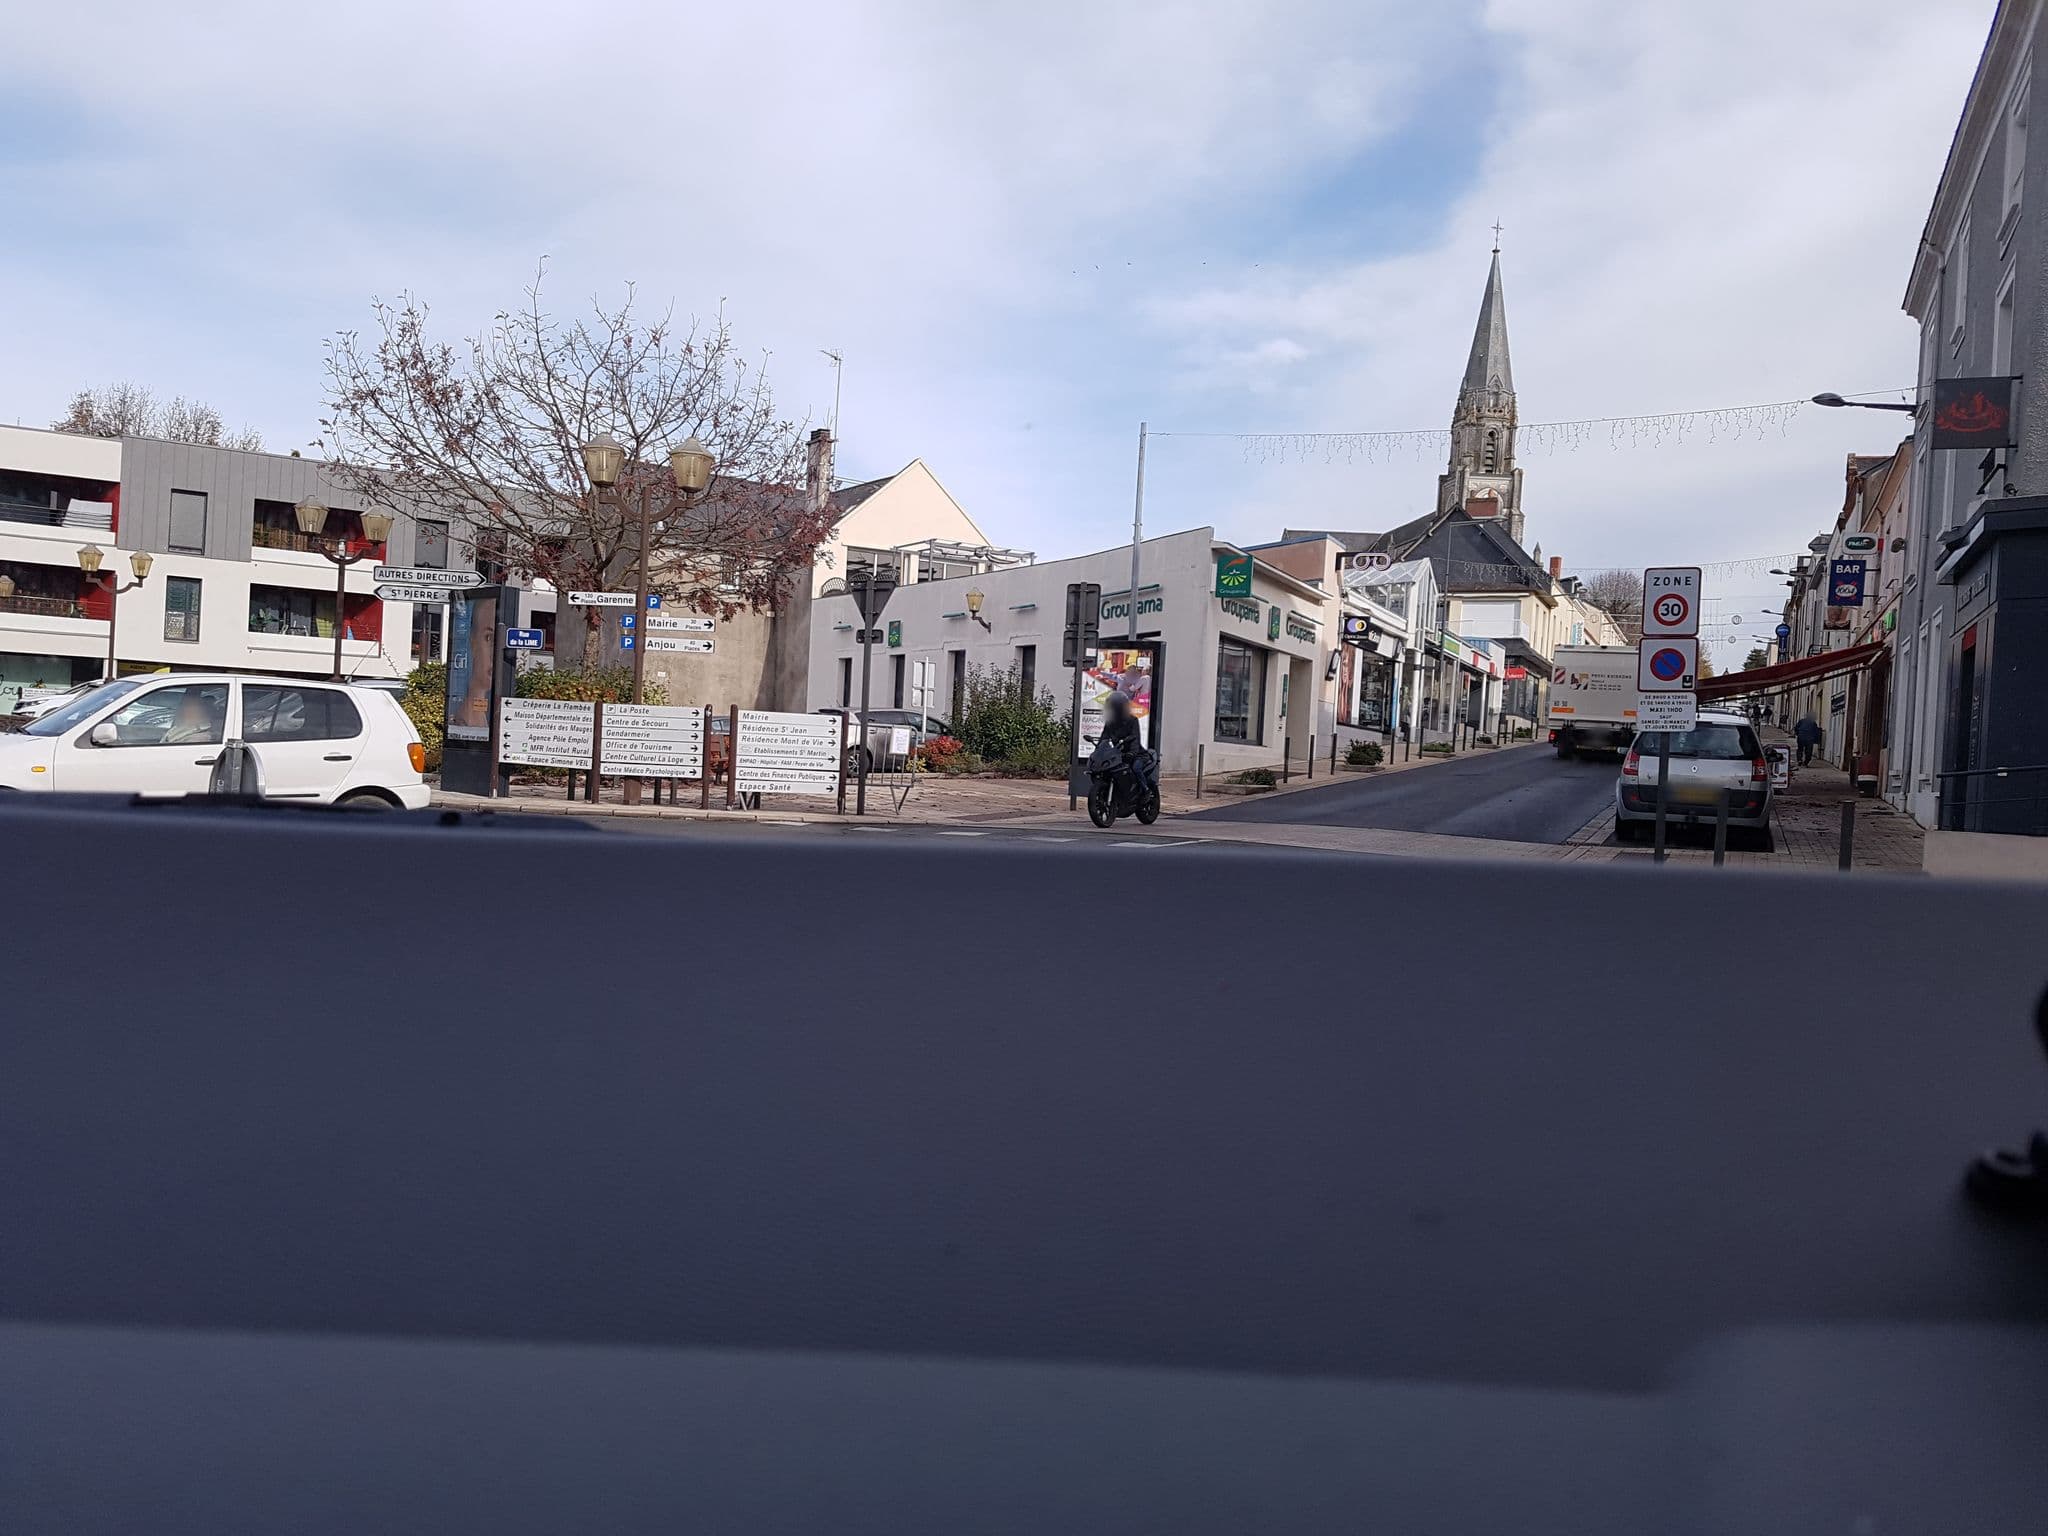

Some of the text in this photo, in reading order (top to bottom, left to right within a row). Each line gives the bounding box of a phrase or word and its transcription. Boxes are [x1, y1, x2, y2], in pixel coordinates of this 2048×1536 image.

[1836, 564, 1860, 574] BAR
[378, 570, 470, 584] AUTRES DIRECTIONS
[1652, 576, 1692, 586] ZONE
[404, 590, 439, 600] PIERRE
[596, 595, 634, 604] Garenne
[650, 598, 658, 606] P
[1101, 598, 1164, 620] Grouama
[1660, 604, 1682, 617] 30
[625, 617, 633, 626] P
[648, 619, 678, 628] Mairie
[1286, 616, 1316, 644] Groupama
[624, 638, 632, 647] P
[647, 640, 676, 650] Anjou
[522, 700, 551, 709] Crêperie
[563, 703, 591, 711] Flambée
[514, 711, 534, 719] Maison
[536, 712, 580, 722] Départementale
[606, 718, 629, 726] Centre
[525, 722, 556, 730] Solidarités
[570, 724, 592, 734] Mauges
[742, 724, 779, 733] Résidence
[528, 734, 551, 743] Agence
[568, 736, 589, 744] Emploi
[606, 730, 650, 738] Gendarmerie
[741, 735, 778, 744] Résidence
[546, 746, 570, 754] Institut
[526, 755, 549, 763] Espace
[550, 757, 573, 765] Simone
[629, 754, 656, 762] Culturel
[645, 768, 686, 776] Psychologique
[772, 771, 796, 779] Finances
[798, 772, 826, 781] Publiques
